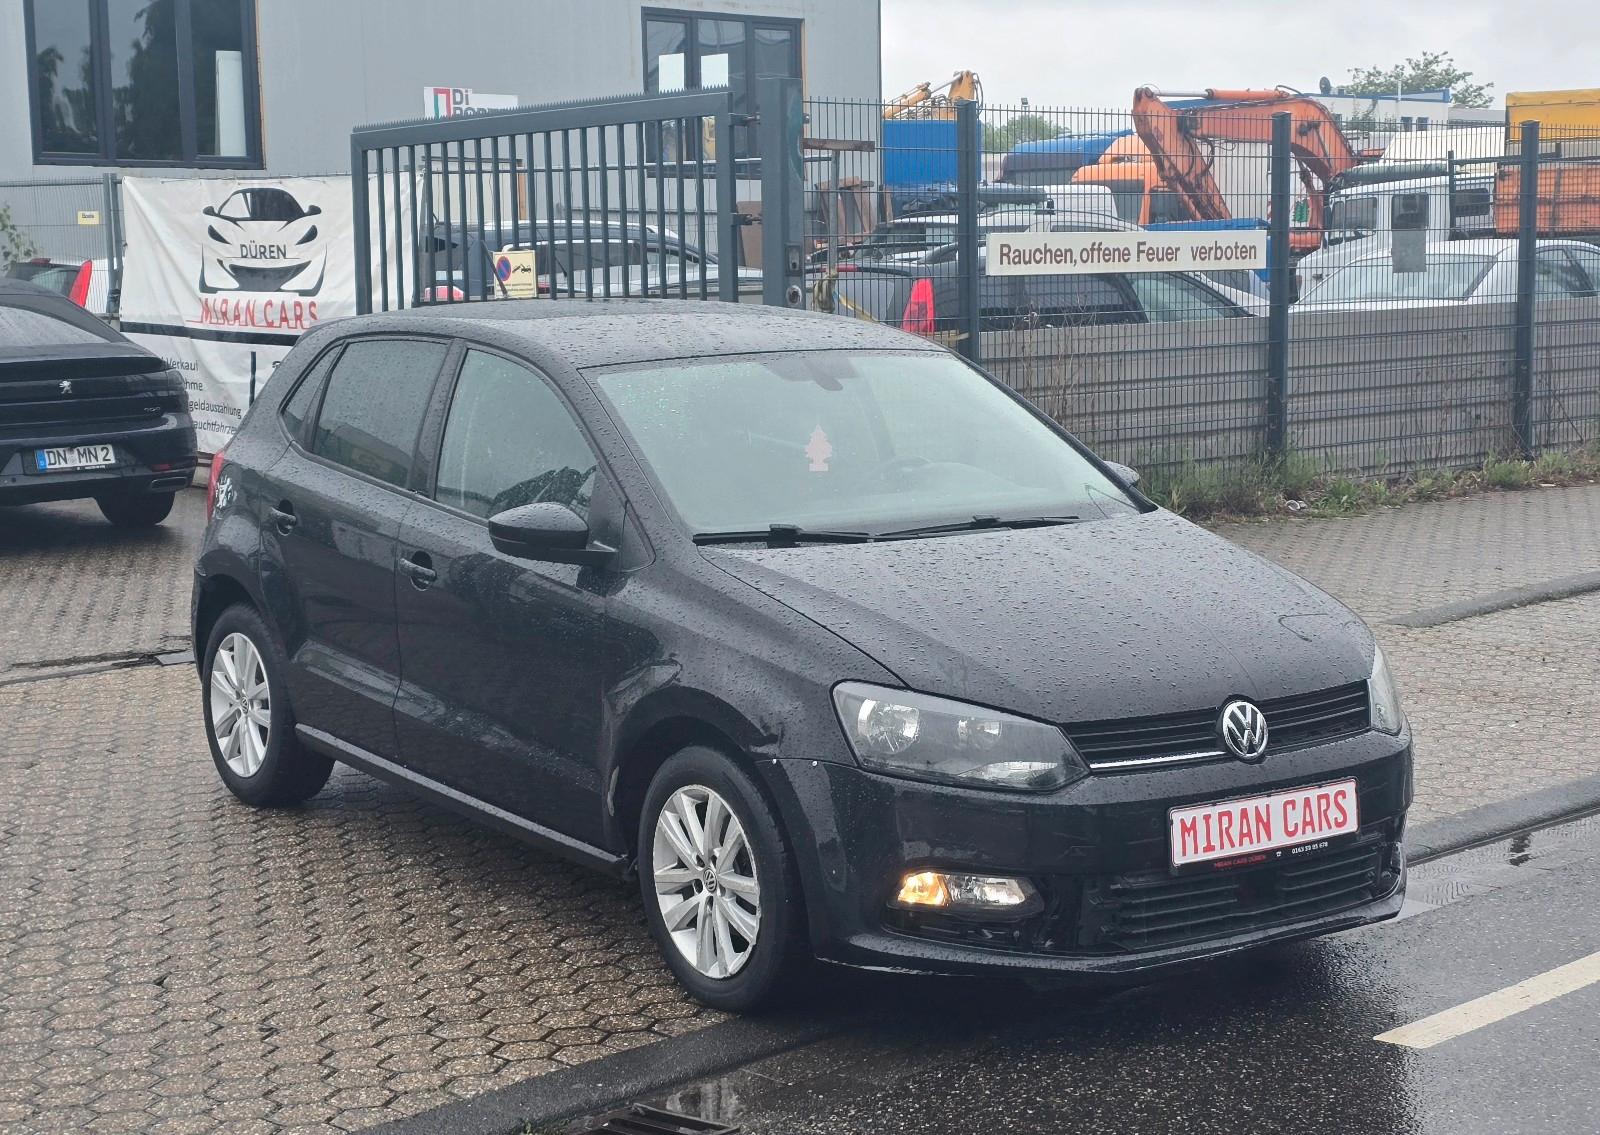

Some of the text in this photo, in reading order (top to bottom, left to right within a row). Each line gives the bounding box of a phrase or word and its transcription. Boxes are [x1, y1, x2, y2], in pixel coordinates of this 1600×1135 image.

[452, 88, 470, 105] Di
[240, 240, 287, 259] DÜREN
[999, 240, 1257, 267] Rauchen, offene Feuer verboten
[200, 298, 318, 329] MIRAN CARS
[188, 398, 242, 419] geldauszahlung
[46, 446, 111, 466] DN MN 2
[1179, 789, 1348, 857] MIRAN CARS
